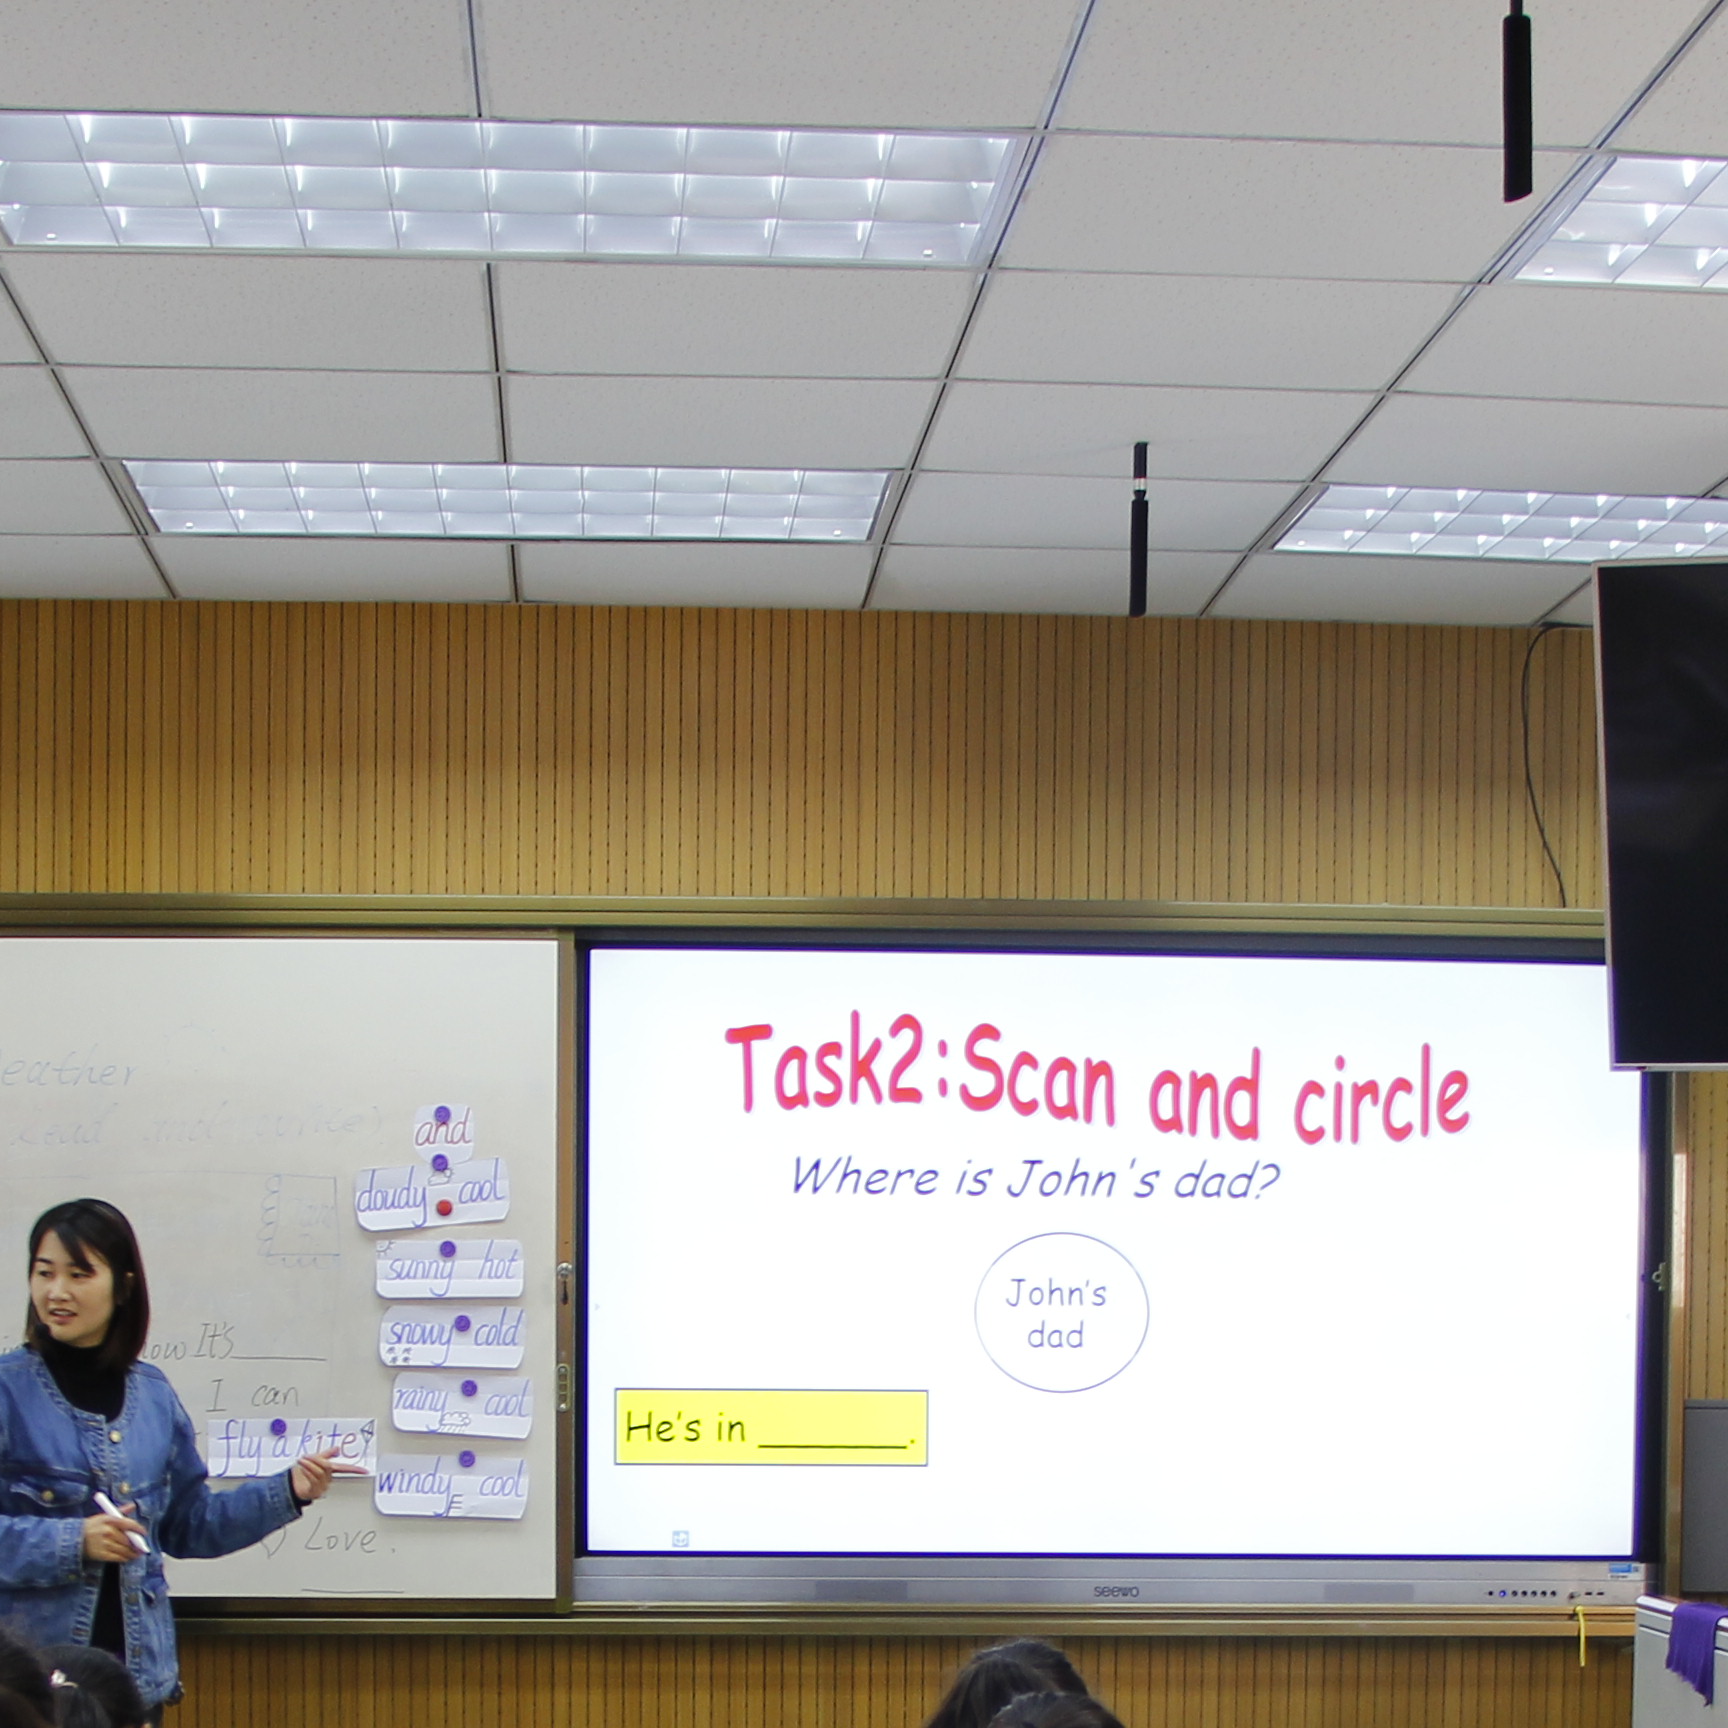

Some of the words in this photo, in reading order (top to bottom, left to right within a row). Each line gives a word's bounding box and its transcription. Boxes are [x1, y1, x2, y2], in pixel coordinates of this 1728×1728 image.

[1149, 1046, 1261, 1140] and
[1294, 1043, 1470, 1145] circle
[415, 1107, 472, 1146] and
[459, 1157, 505, 1204] cool
[793, 1155, 939, 1196] Where
[956, 1159, 992, 1196] is
[1007, 1157, 1160, 1198] John's
[1174, 1158, 1281, 1199] dad?
[386, 1258, 456, 1297] sunny
[478, 1239, 518, 1279] hot
[1006, 1278, 1107, 1307] John's
[191, 1321, 235, 1359] It's
[386, 1322, 456, 1367] snowy
[474, 1307, 524, 1346] cold
[1027, 1320, 1083, 1348] dad
[206, 1378, 226, 1412] I
[251, 1384, 299, 1407] can
[394, 1386, 448, 1433] rainy
[484, 1379, 530, 1417] cool
[217, 1419, 265, 1477] fly
[272, 1434, 290, 1458] a
[298, 1419, 360, 1459] kite
[625, 1410, 701, 1442] He's
[717, 1412, 745, 1442] in
[378, 1456, 452, 1517] windy
[479, 1459, 524, 1497] cool
[1094, 1586, 1139, 1598] seewo
